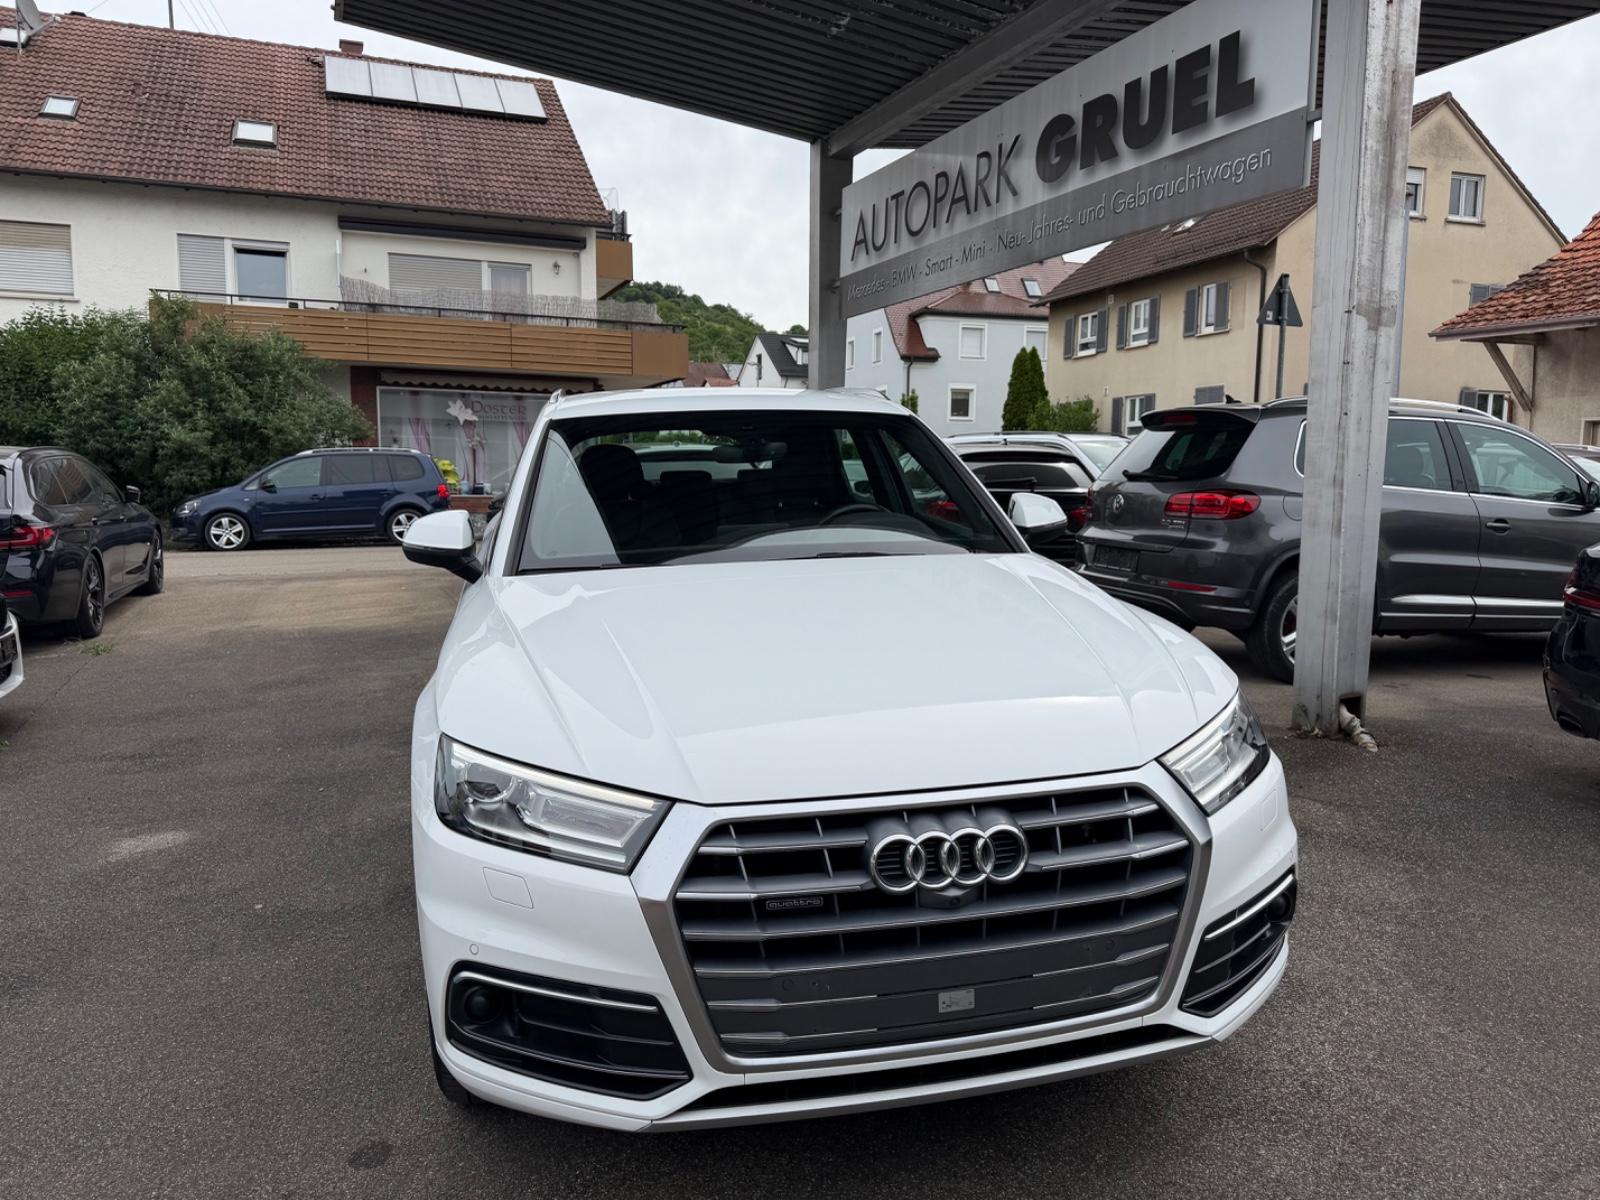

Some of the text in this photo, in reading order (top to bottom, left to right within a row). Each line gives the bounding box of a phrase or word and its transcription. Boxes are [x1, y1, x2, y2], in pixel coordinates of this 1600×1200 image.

[851, 30, 1255, 262] AUTOPARK GRUEL
[892, 263, 917, 288] BMW
[925, 254, 952, 277] Smart
[961, 240, 986, 265] Mini
[1078, 193, 1106, 226] und
[1111, 148, 1272, 213] Gebrauchtwagen
[768, 898, 821, 910] quattro
